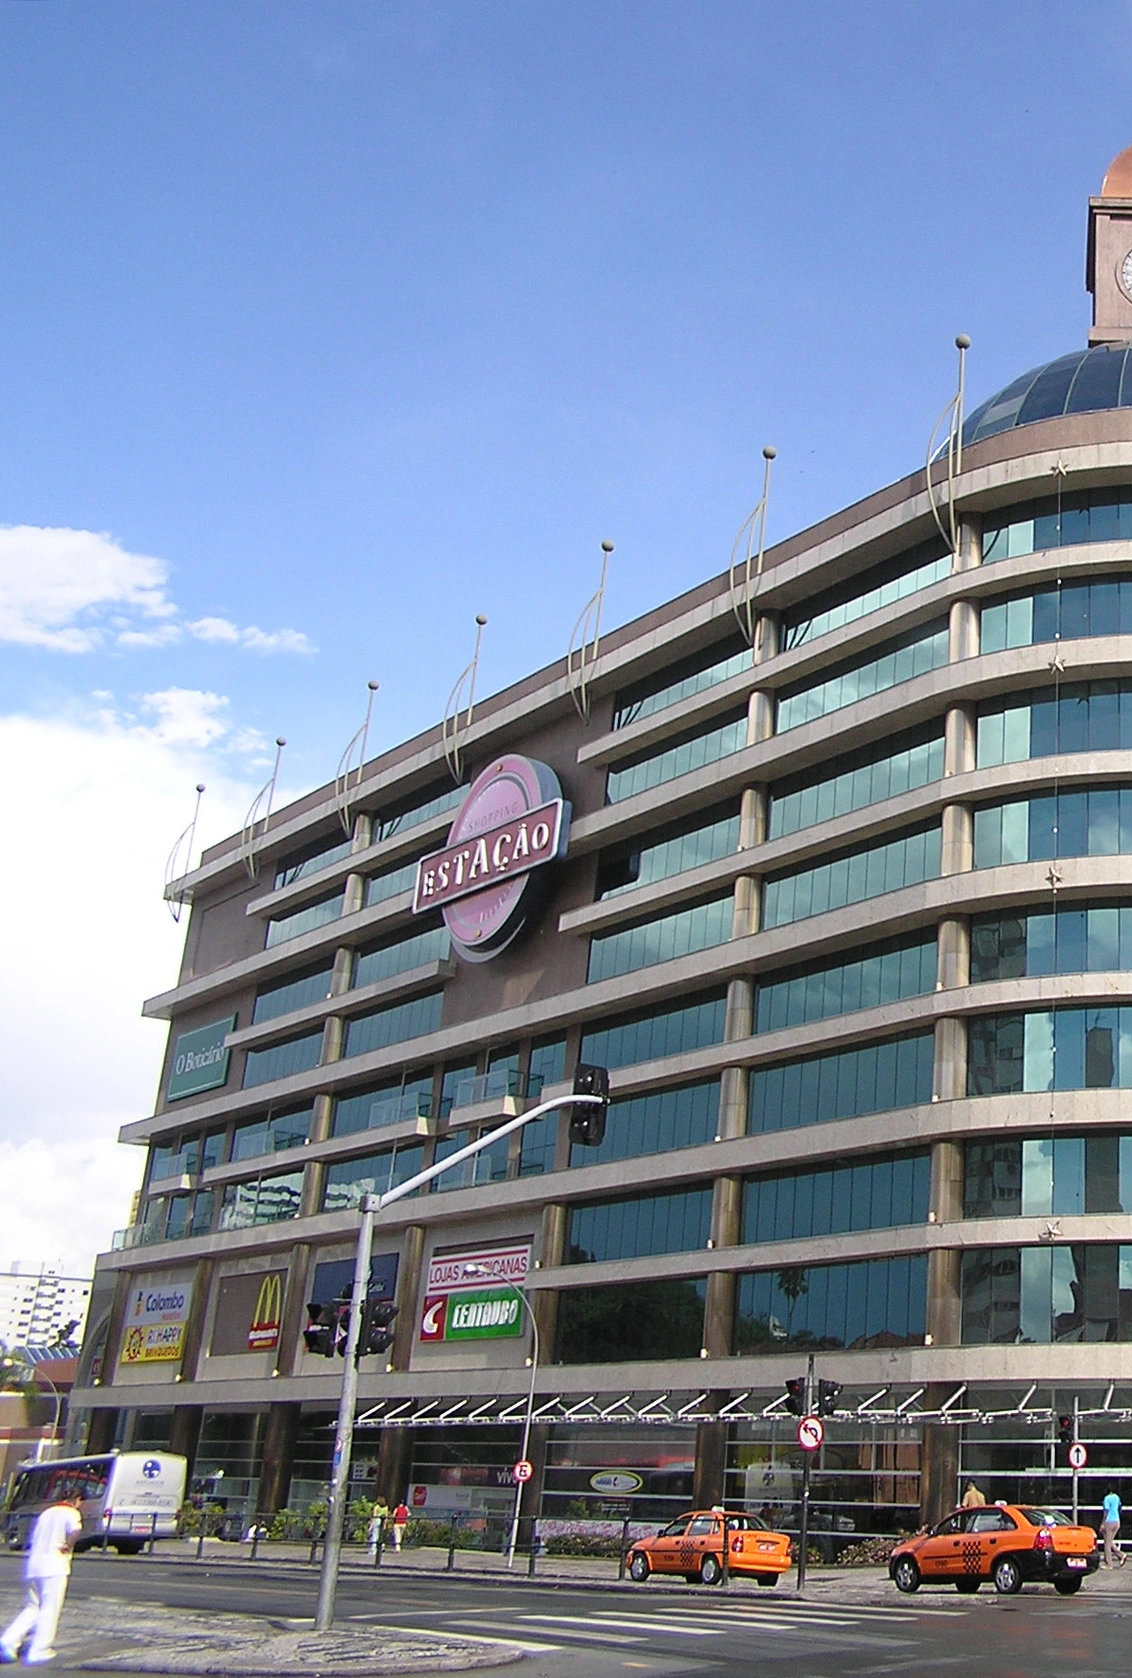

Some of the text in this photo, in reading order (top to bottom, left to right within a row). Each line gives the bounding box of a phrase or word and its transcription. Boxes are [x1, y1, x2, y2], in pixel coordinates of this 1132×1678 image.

[468, 801, 519, 831] SHOPPING
[422, 822, 550, 897] ESTAÇÃO
[176, 1054, 186, 1076] O
[429, 1256, 528, 1284] LOJAS ERICANAS
[146, 1291, 185, 1312] Colombo
[451, 1299, 519, 1329] CENTAURO
